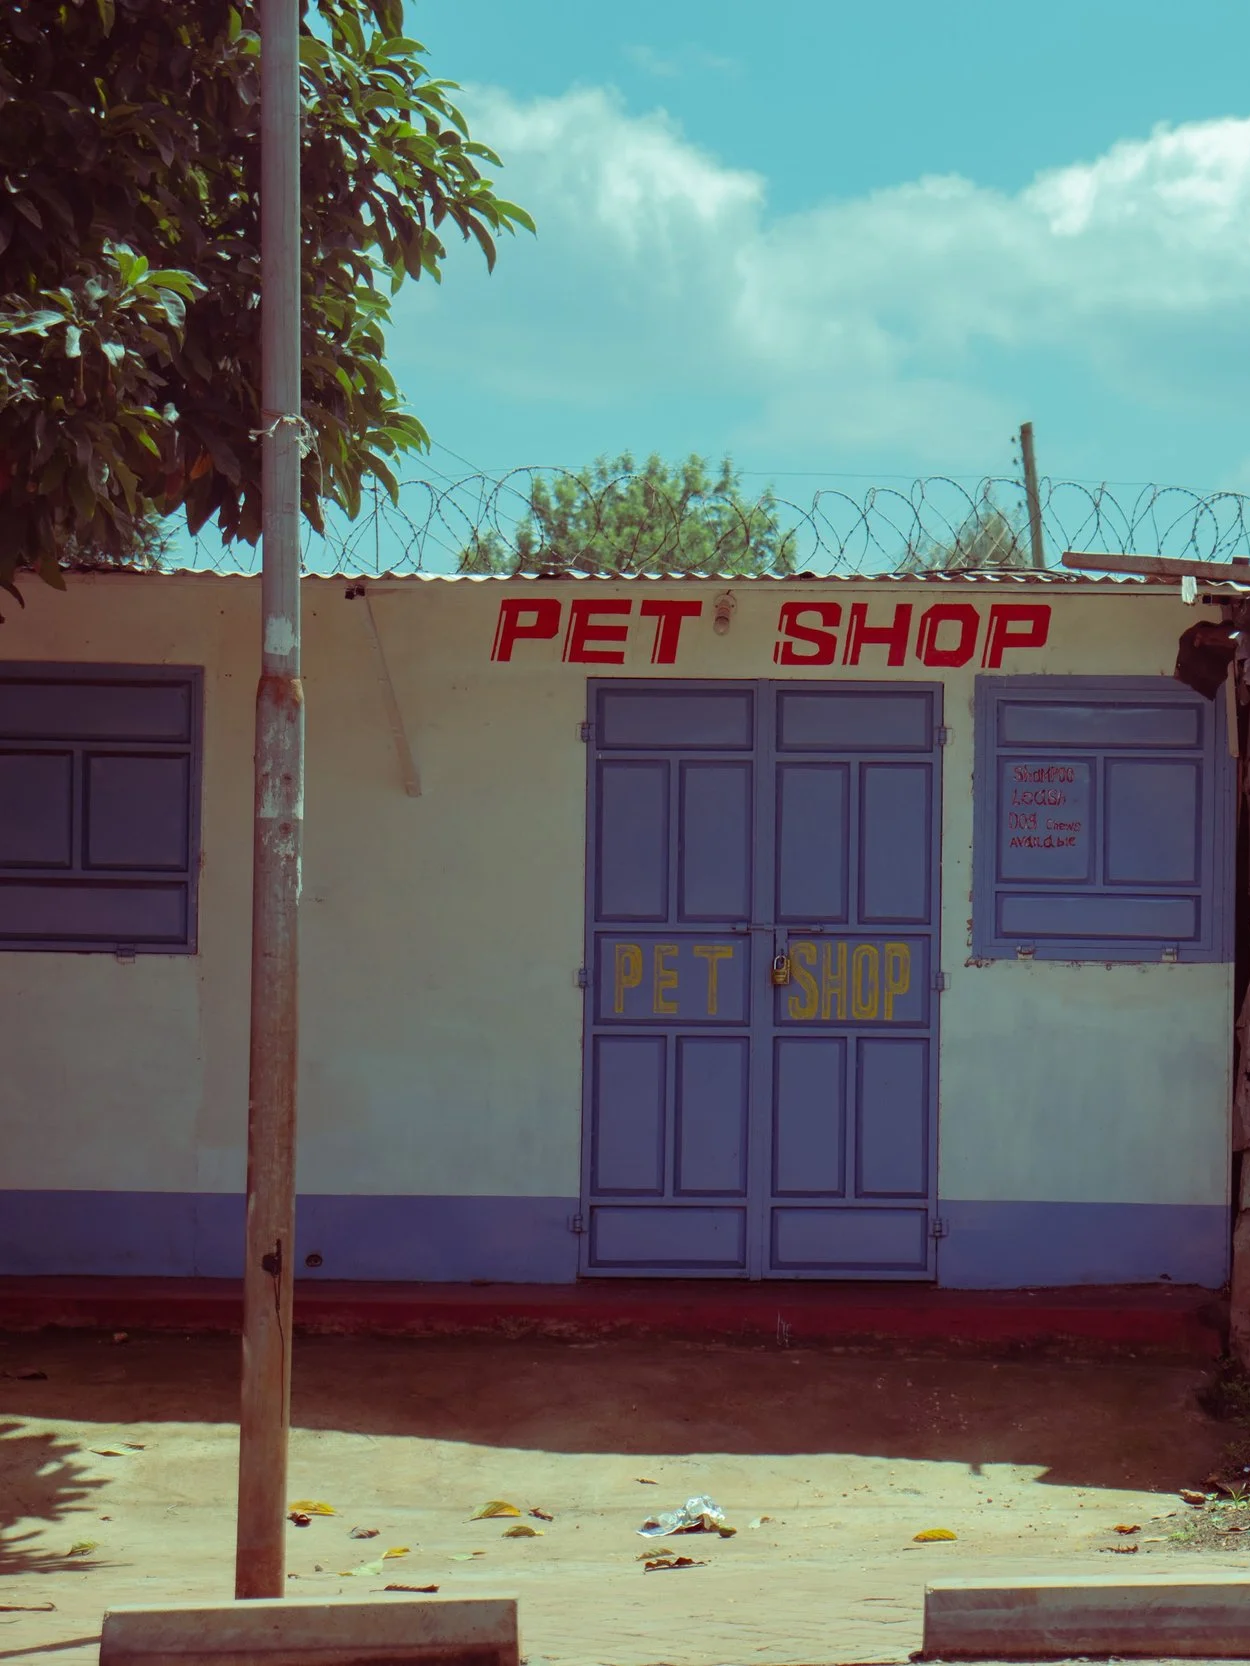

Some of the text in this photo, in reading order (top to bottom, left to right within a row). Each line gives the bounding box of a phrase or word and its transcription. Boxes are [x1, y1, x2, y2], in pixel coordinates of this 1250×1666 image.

[490, 598, 1052, 668] PET SHOP
[613, 940, 911, 1021] PET SHOP
